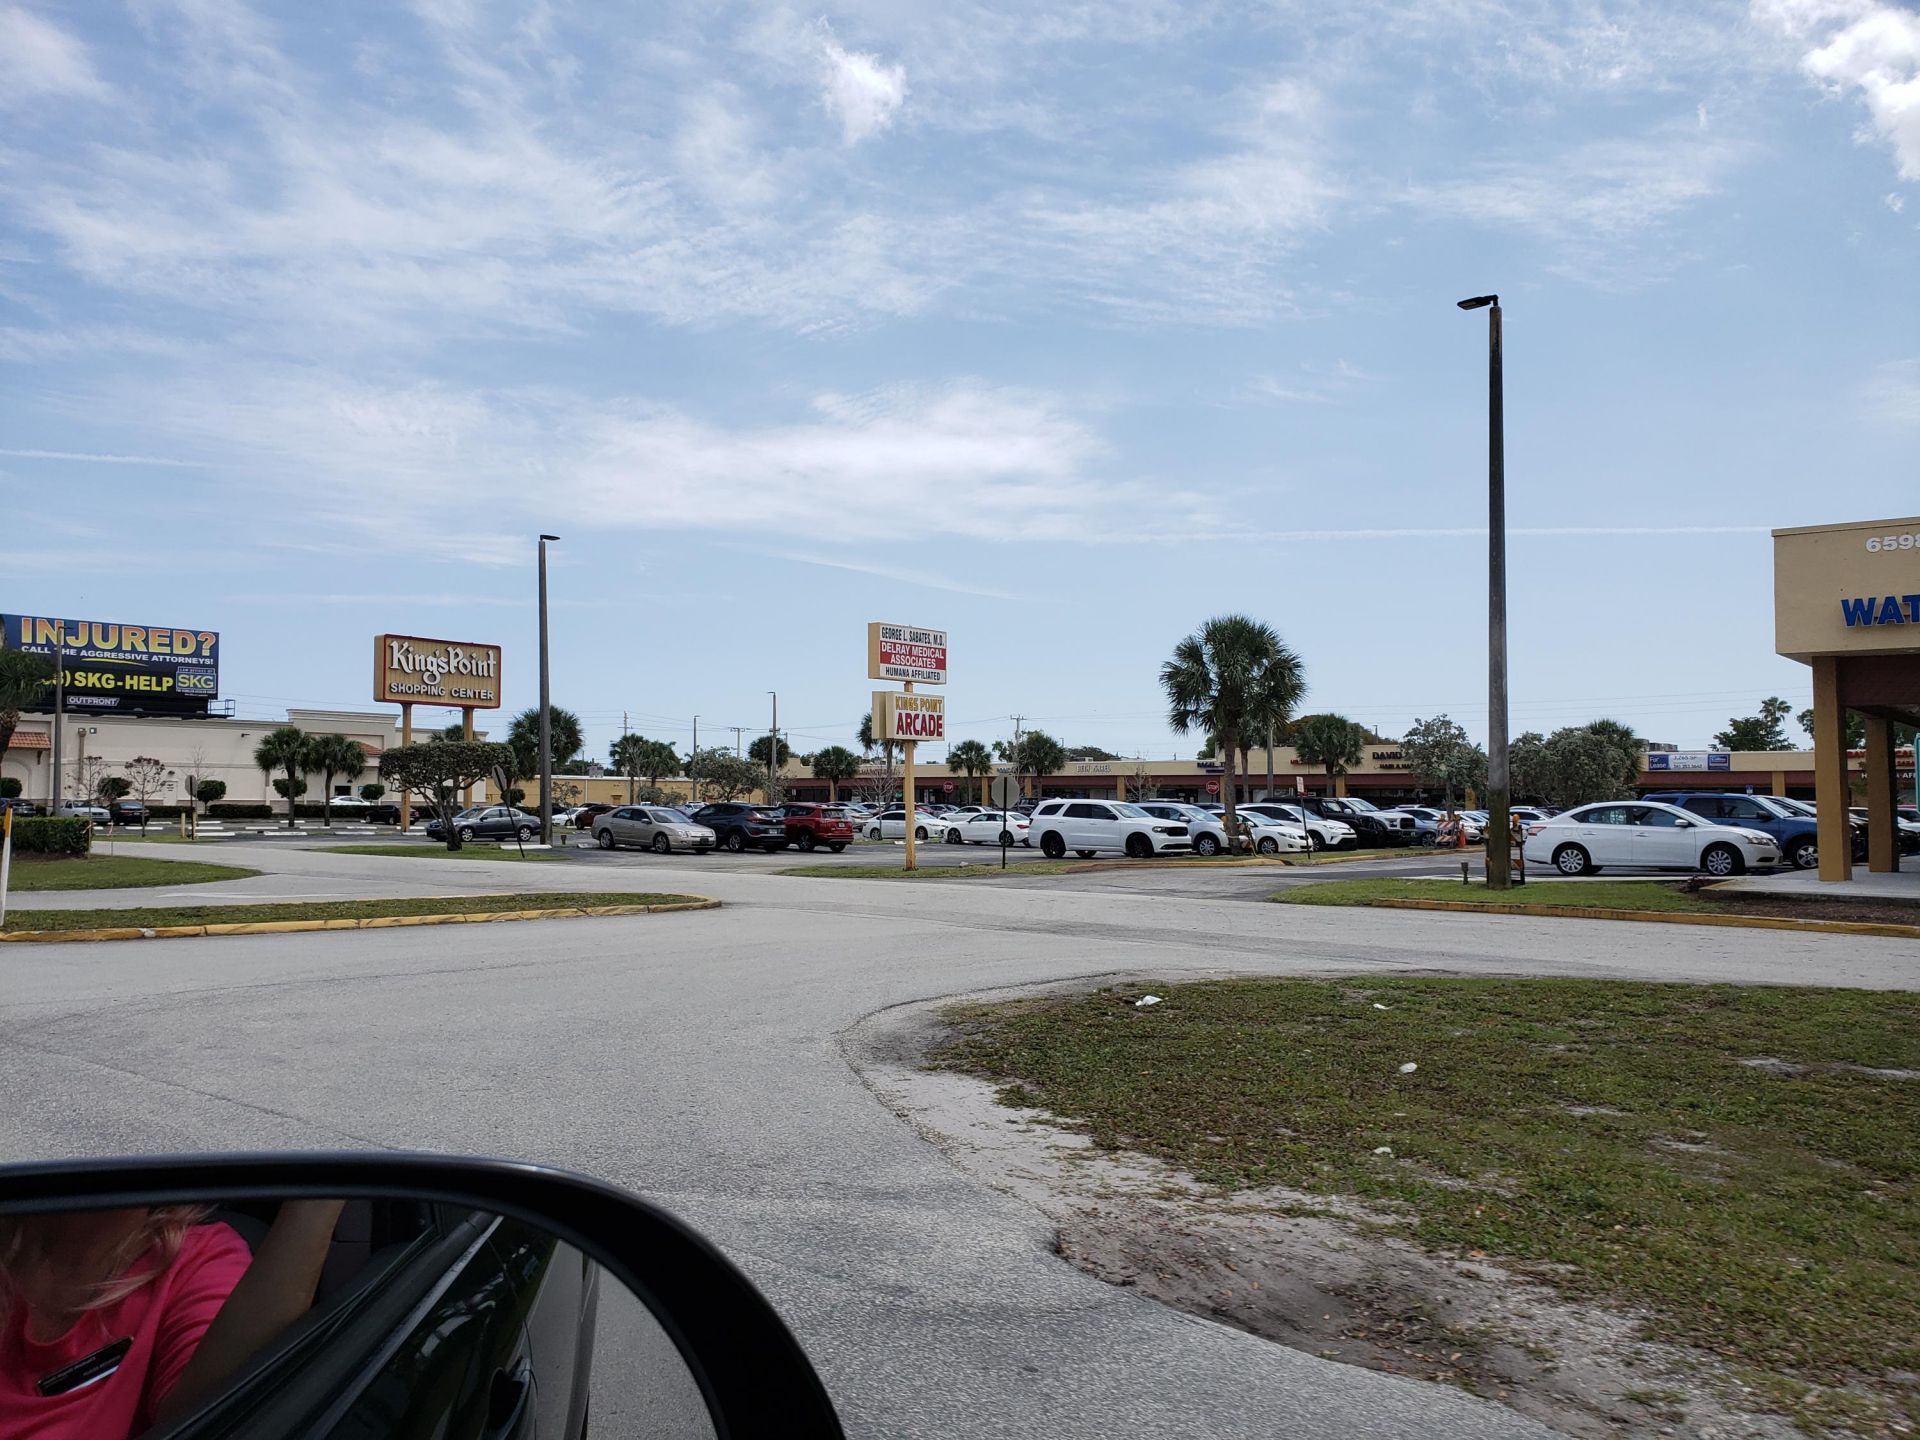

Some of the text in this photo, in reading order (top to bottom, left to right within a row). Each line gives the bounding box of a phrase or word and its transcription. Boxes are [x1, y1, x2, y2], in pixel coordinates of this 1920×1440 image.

[21, 617, 216, 656] INJURED?
[881, 626, 945, 647] GEORGE L. SABATES, M.D.
[21, 646, 51, 654] CALL
[80, 650, 149, 661] AGGRESSIVE
[151, 655, 214, 665] ATTORNEYS!
[881, 641, 944, 659] DELRAY MEDICAL
[447, 646, 496, 678] Point
[890, 655, 936, 668] ASSOCIATES
[74, 671, 174, 692] SKG-HELP
[178, 673, 214, 689] SKG
[885, 667, 940, 681] HUMANA AFFILIATED
[390, 682, 494, 700] SHOPPING CENTER
[69, 695, 117, 706] OUTFRONT
[895, 696, 943, 713] KINGS POINT
[896, 712, 943, 737] ARCADE
